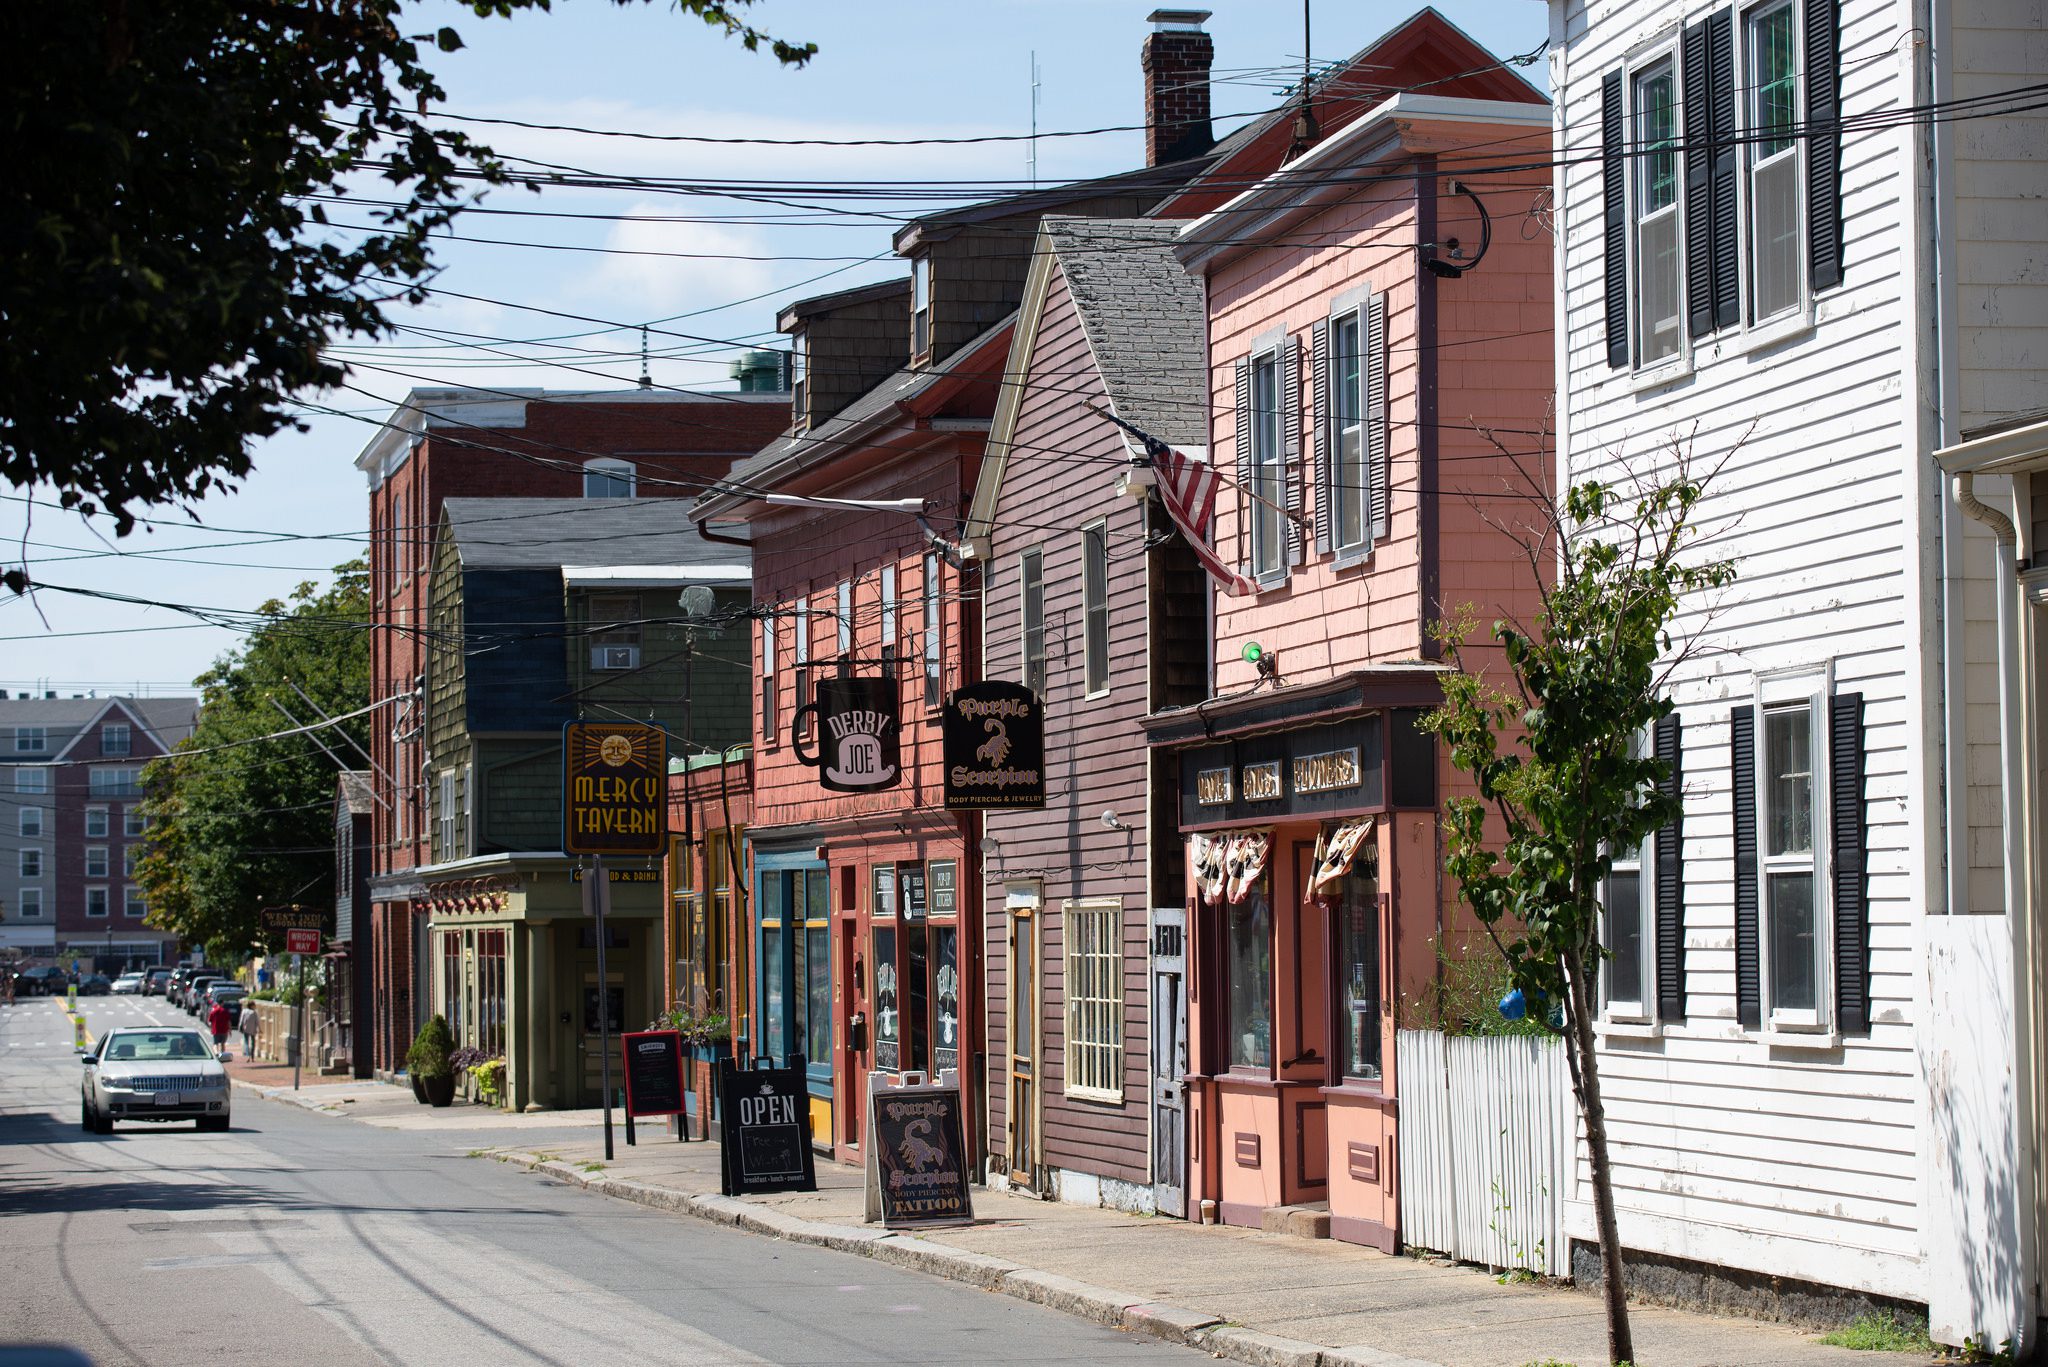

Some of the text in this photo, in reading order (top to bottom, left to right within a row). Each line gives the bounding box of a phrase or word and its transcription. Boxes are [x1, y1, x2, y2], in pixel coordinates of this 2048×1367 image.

[957, 698, 1029, 722] Purple
[827, 710, 890, 740] DERBY
[845, 744, 874, 774] JOE
[951, 765, 1039, 790] Scorpion
[575, 777, 657, 802] MERCY
[949, 796, 969, 804] BODY
[575, 808, 657, 834] TAVERN
[622, 872, 631, 881] &
[633, 871, 657, 881] DRINK
[937, 871, 951, 887] POP-UP
[936, 893, 953, 907] KITCHEN
[266, 912, 328, 921] WEST INDIA
[291, 933, 317, 941] WRONG
[296, 942, 311, 951] WAY
[740, 1095, 796, 1126] OPEN
[886, 1100, 948, 1122] Purple
[890, 1169, 960, 1188] Scorpion
[895, 1188, 957, 1198] BODY PIERCING
[893, 1197, 961, 1213] TATTOO
